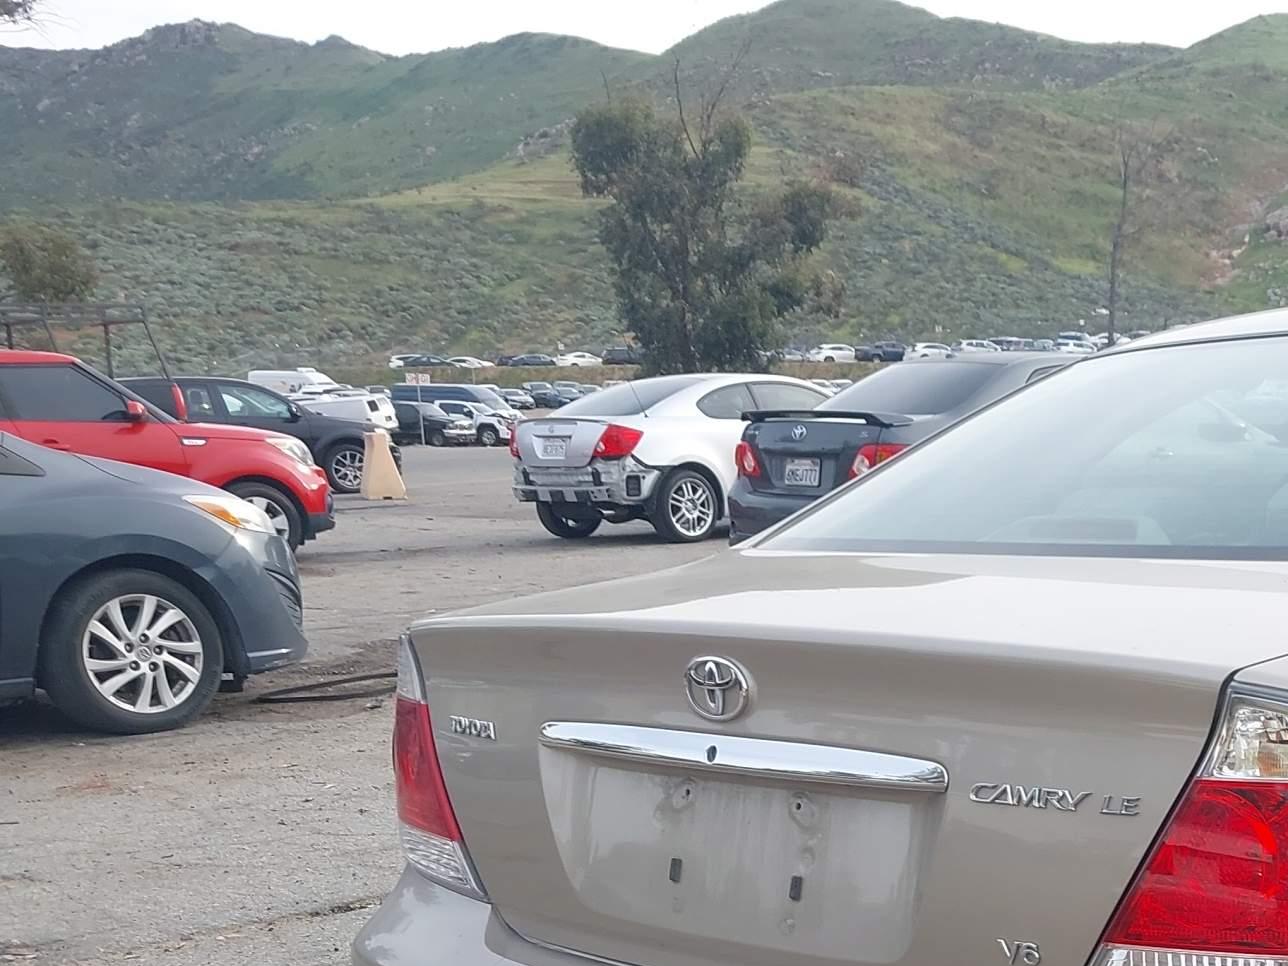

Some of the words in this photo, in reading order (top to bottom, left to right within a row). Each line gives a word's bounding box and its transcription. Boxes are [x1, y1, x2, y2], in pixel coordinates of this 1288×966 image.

[448, 715, 497, 740] TOYOTA
[969, 782, 1093, 812] CAMRY
[1099, 795, 1142, 817] LE
[996, 937, 1042, 966] V6
